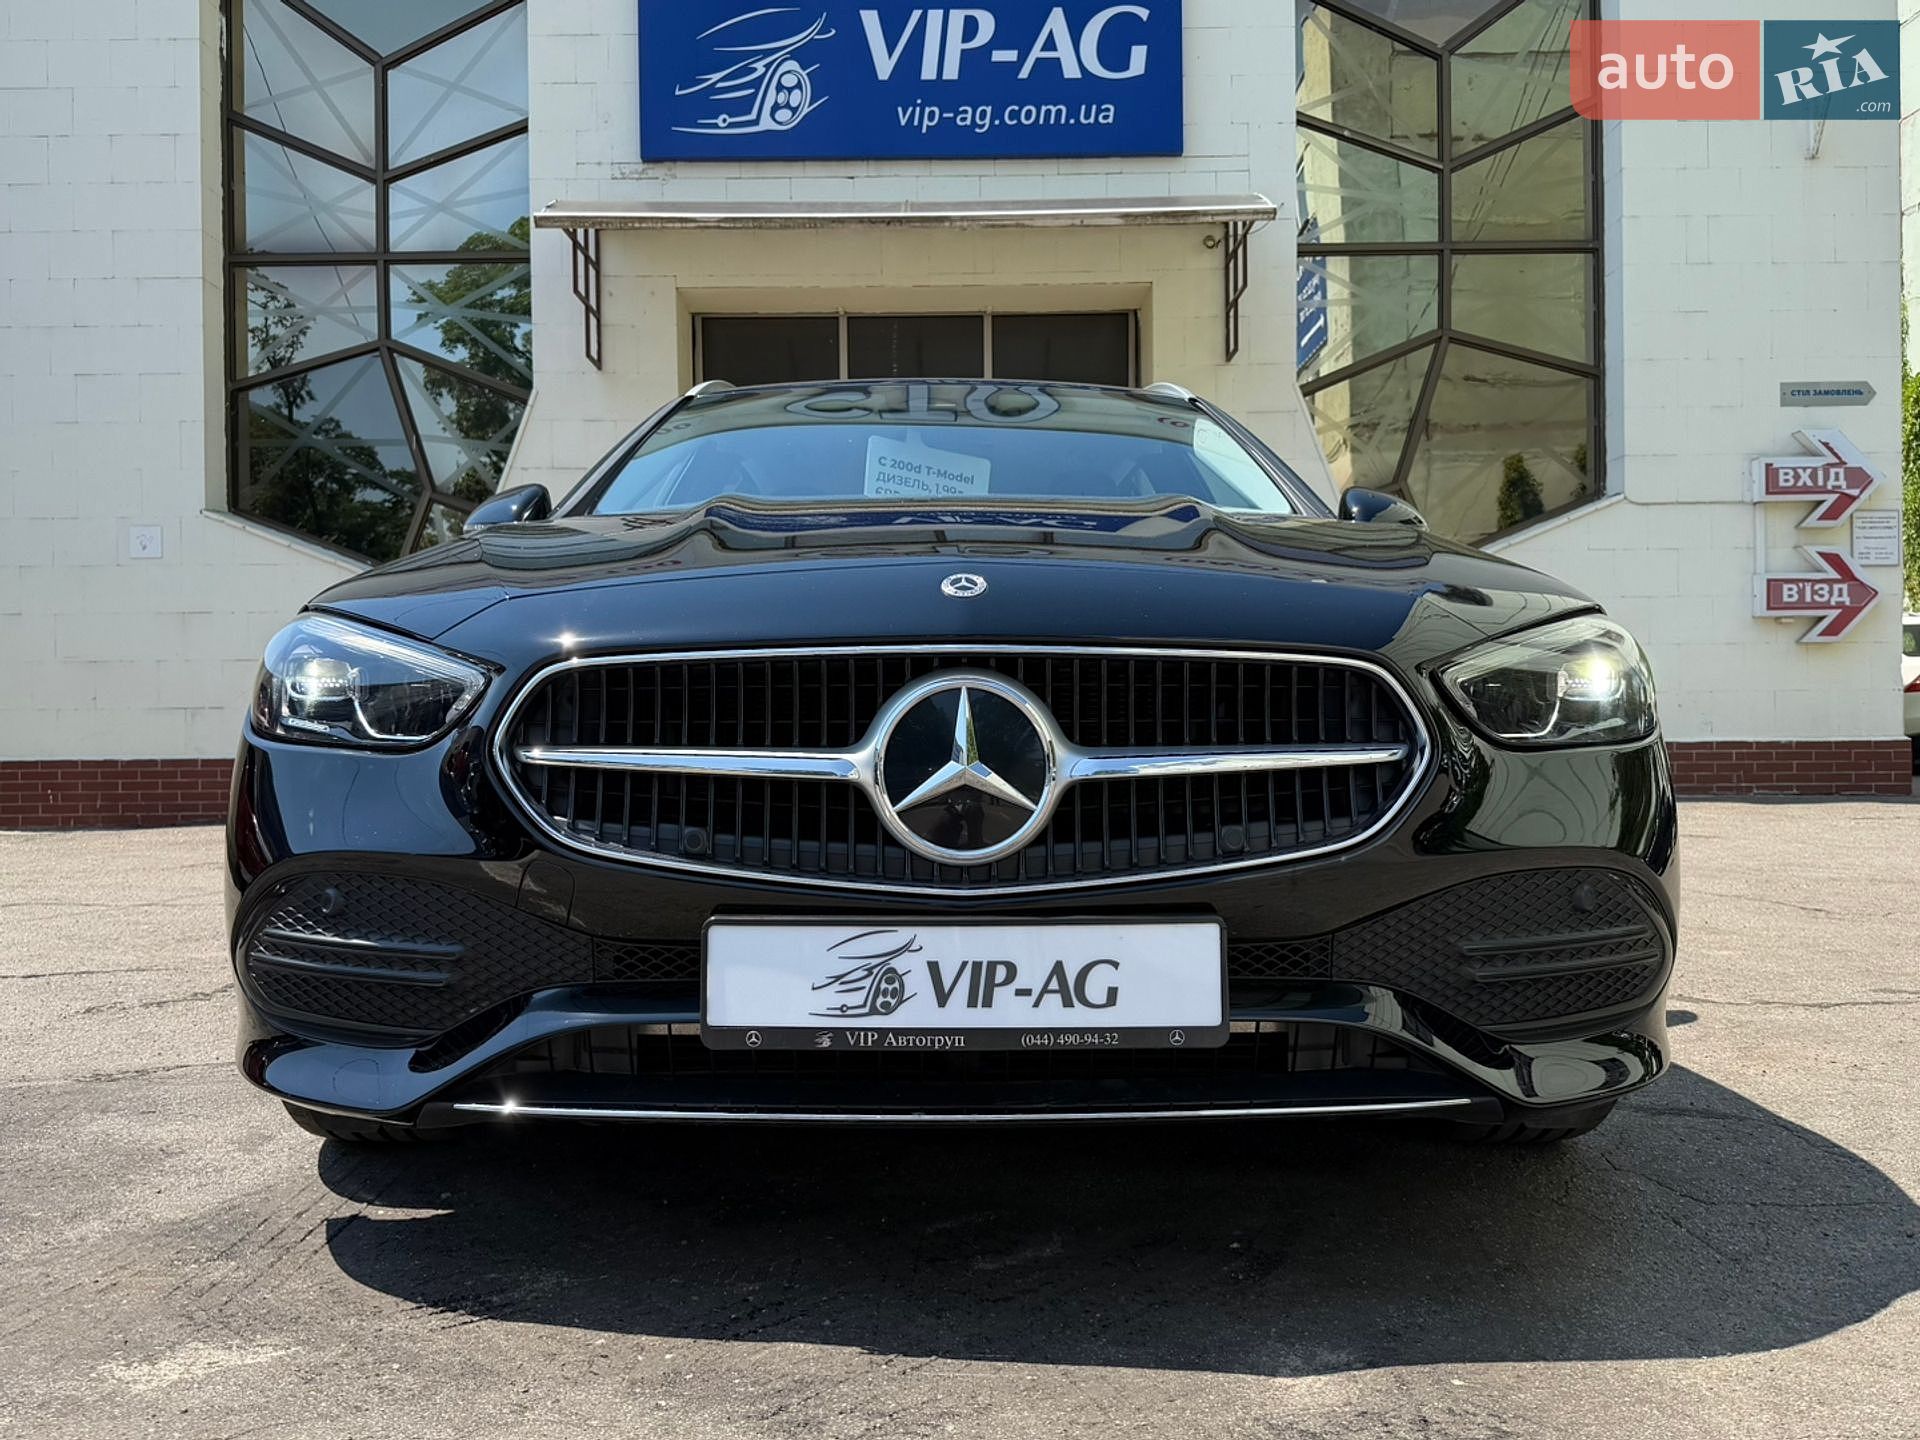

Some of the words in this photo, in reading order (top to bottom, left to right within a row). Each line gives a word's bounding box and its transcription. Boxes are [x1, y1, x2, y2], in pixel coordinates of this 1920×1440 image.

[858, 6, 1150, 81] VIP-AG
[896, 99, 1115, 132] vip-ag.com.ua
[876, 471, 932, 493] ДИЗЕЛЬ,
[890, 459, 922, 474] 200d
[925, 465, 975, 485] T-Model
[1778, 468, 1847, 489] ВХІД
[1782, 582, 1850, 606] В'ЇЗД
[926, 959, 1120, 1008] VIP-AG
[845, 1031, 878, 1046] VIP
[884, 1031, 965, 1049] Автогруп
[1021, 1033, 1054, 1047] (044)
[1057, 1033, 1119, 1045] 490-94-32
